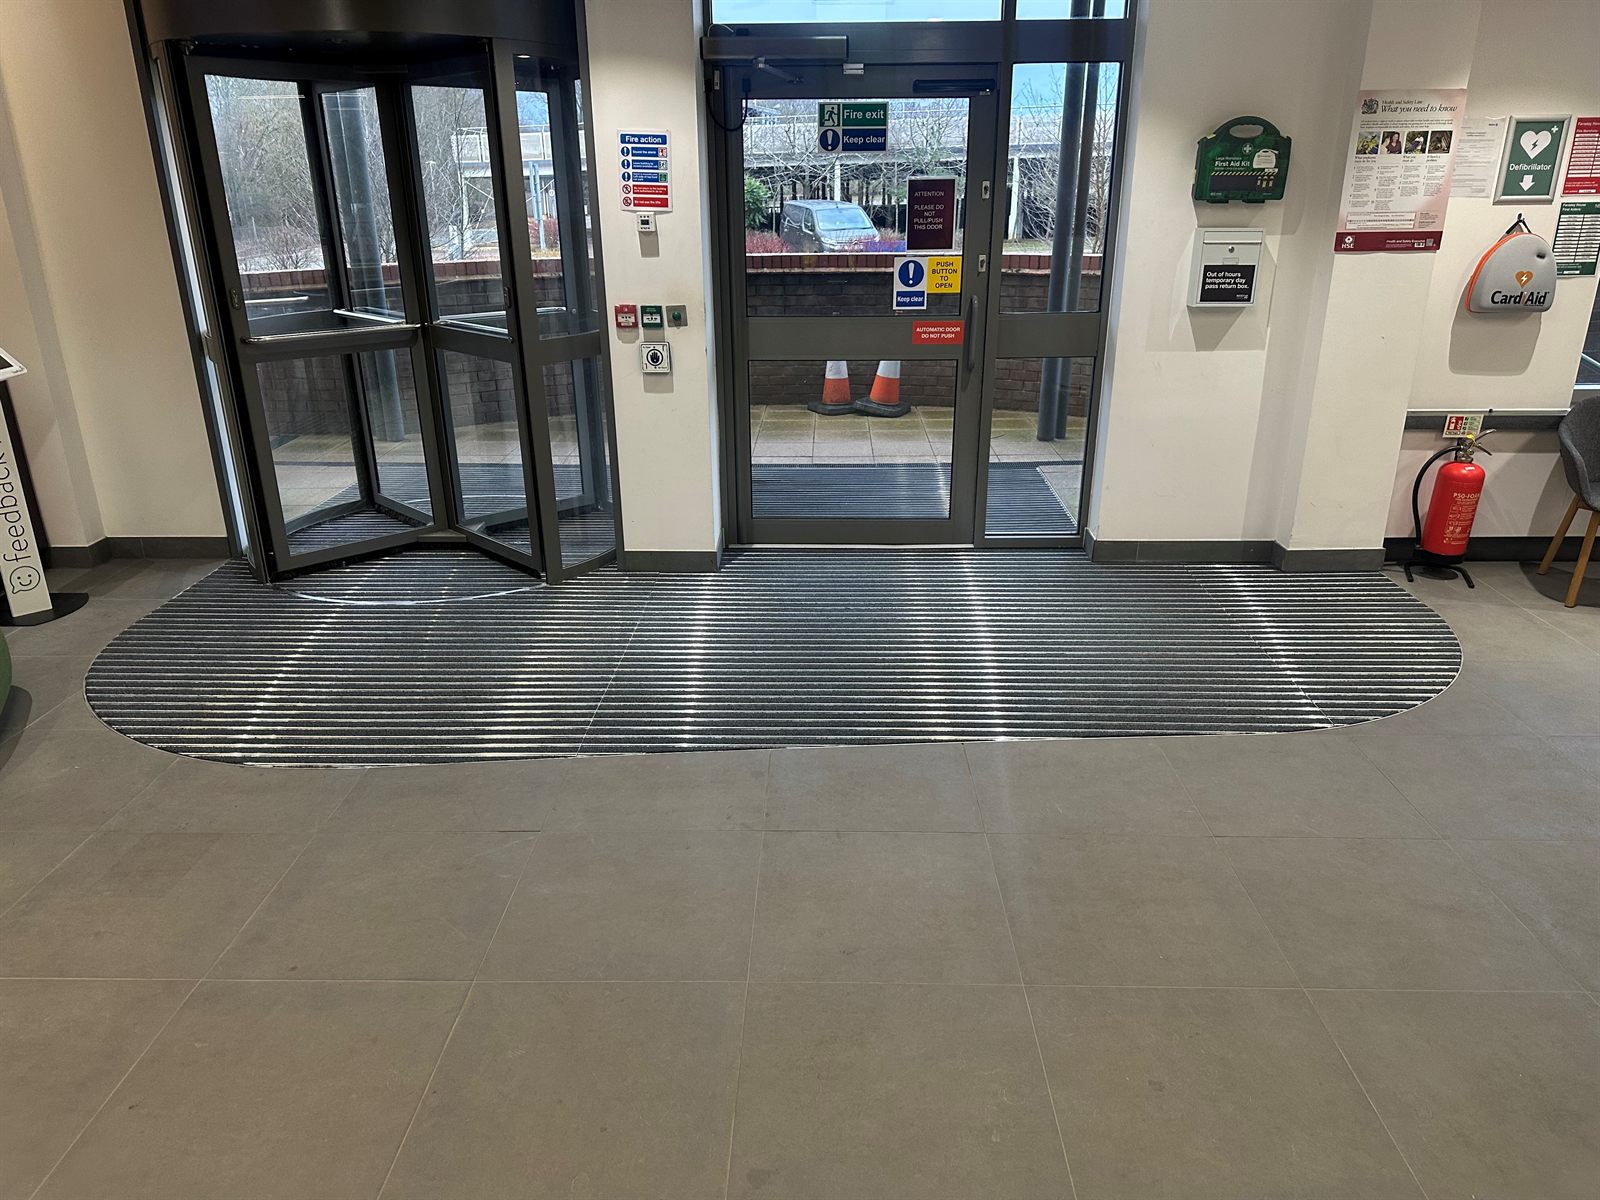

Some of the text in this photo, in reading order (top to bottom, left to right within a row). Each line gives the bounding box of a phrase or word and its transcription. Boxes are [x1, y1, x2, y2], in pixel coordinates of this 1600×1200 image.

[1399, 106, 1412, 114] you
[1412, 104, 1430, 112] need
[1438, 104, 1458, 112] know
[844, 110, 884, 119] Fire exit
[844, 136, 864, 144] Keep
[0, 452, 32, 562] feedbac
